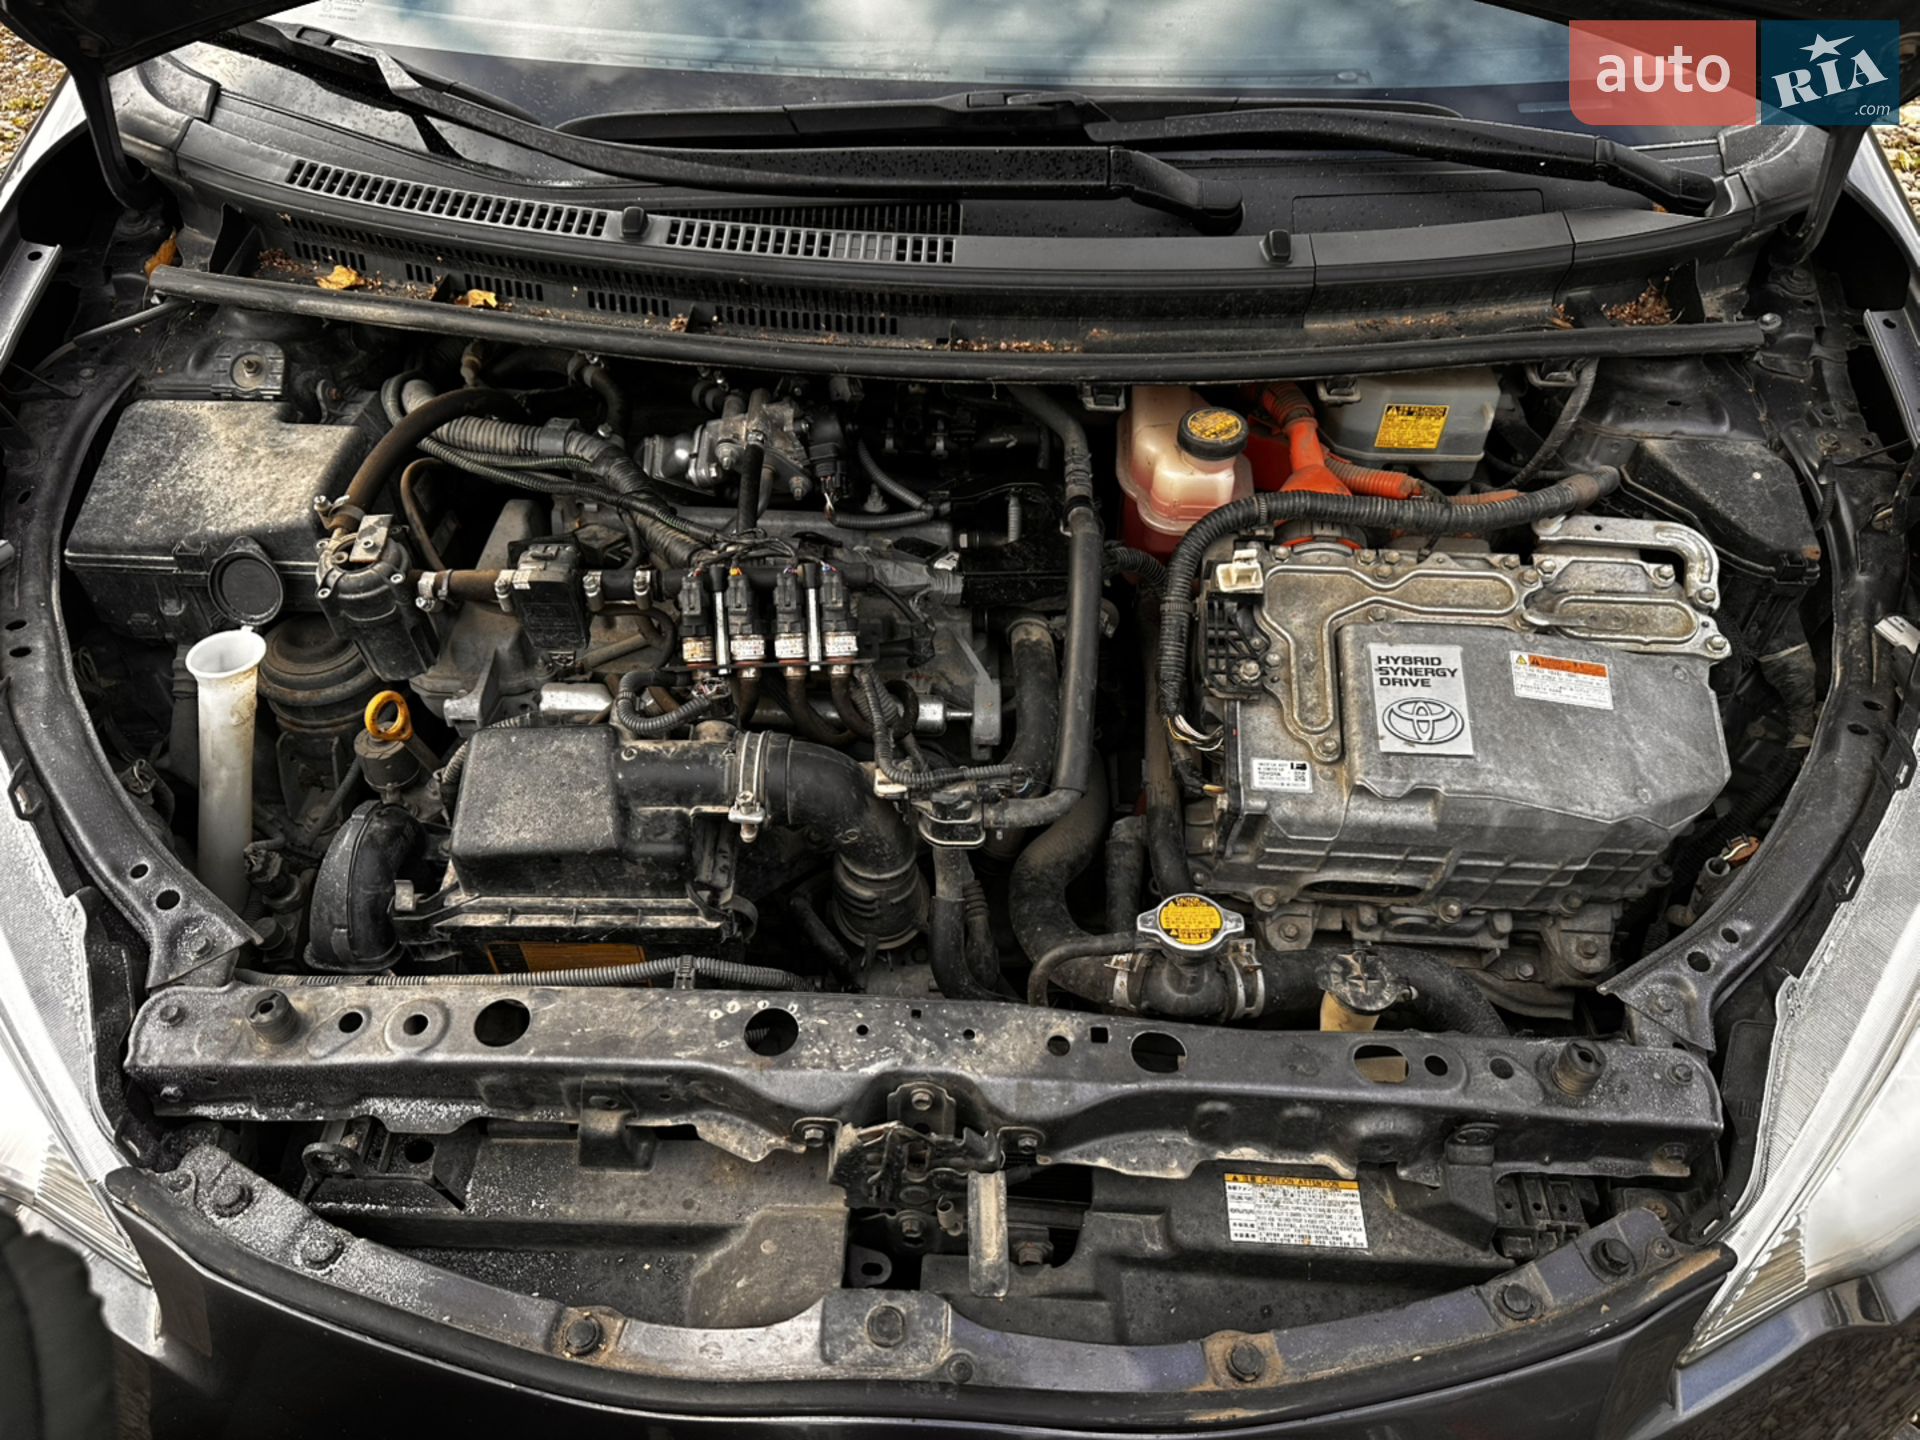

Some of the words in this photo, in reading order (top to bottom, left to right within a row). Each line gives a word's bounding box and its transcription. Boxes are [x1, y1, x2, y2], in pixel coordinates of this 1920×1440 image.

[1377, 655, 1442, 666] HYBRID
[1377, 666, 1458, 677] SYNERGY
[1379, 677, 1432, 687] DRIVE
[1260, 1175, 1294, 1185] CAUTION
[1298, 1178, 1340, 1188] ATTENTION
